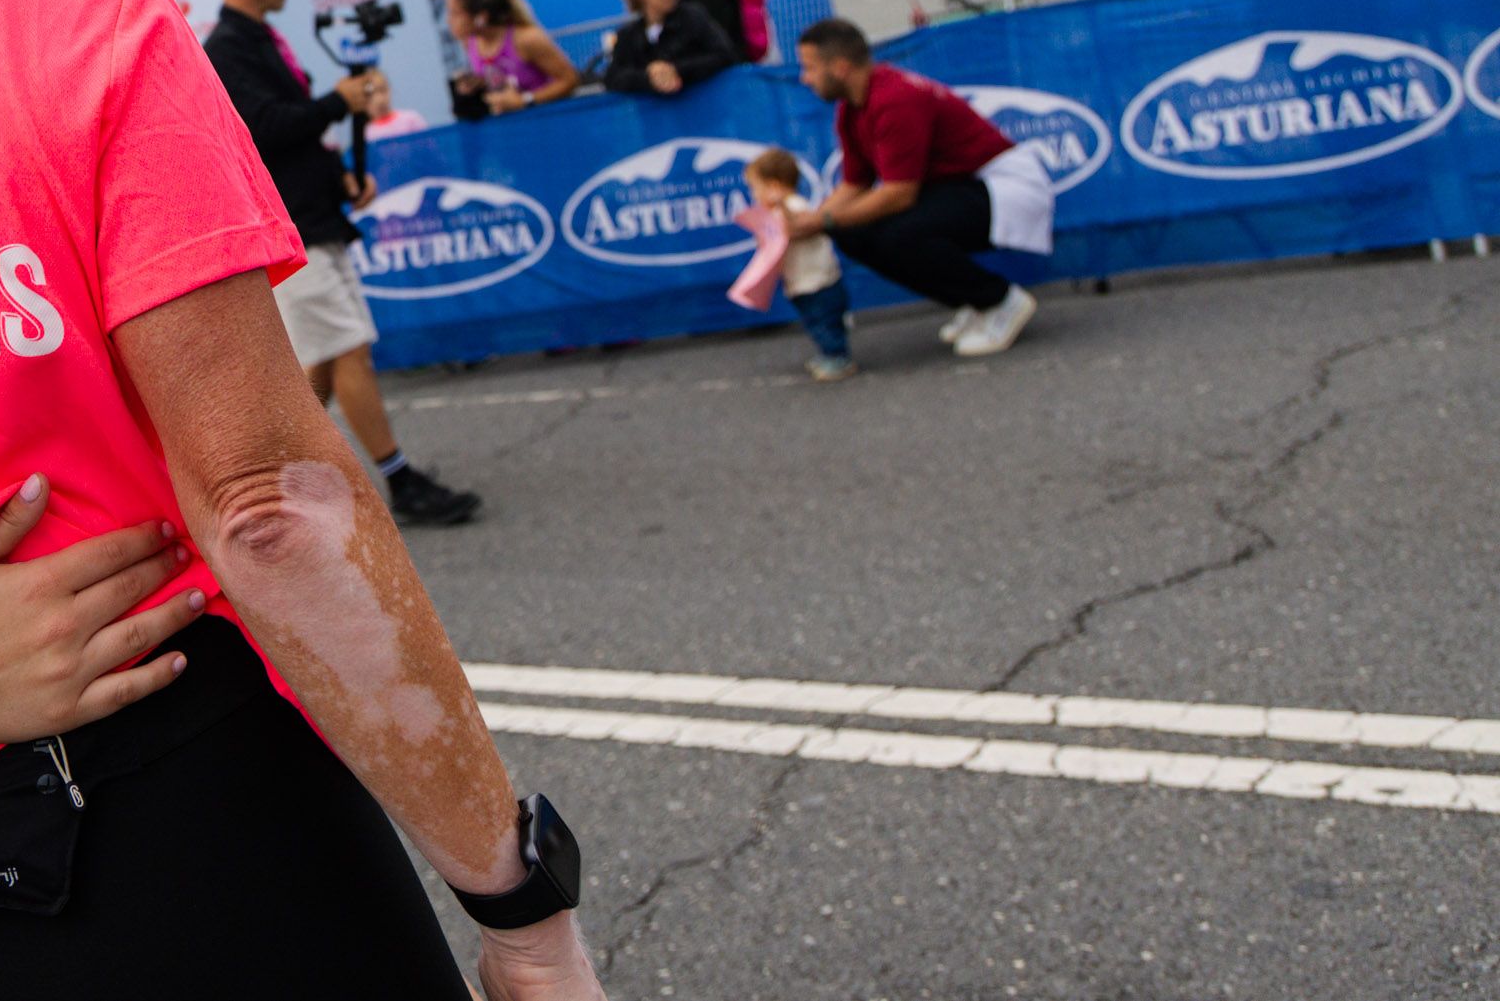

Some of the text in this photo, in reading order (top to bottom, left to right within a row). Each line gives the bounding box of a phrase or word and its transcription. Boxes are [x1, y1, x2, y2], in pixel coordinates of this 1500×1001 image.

[1151, 79, 1438, 156] ASTURIANA
[584, 189, 754, 245] ASTURIA
[351, 221, 536, 276] ASTURIANA
